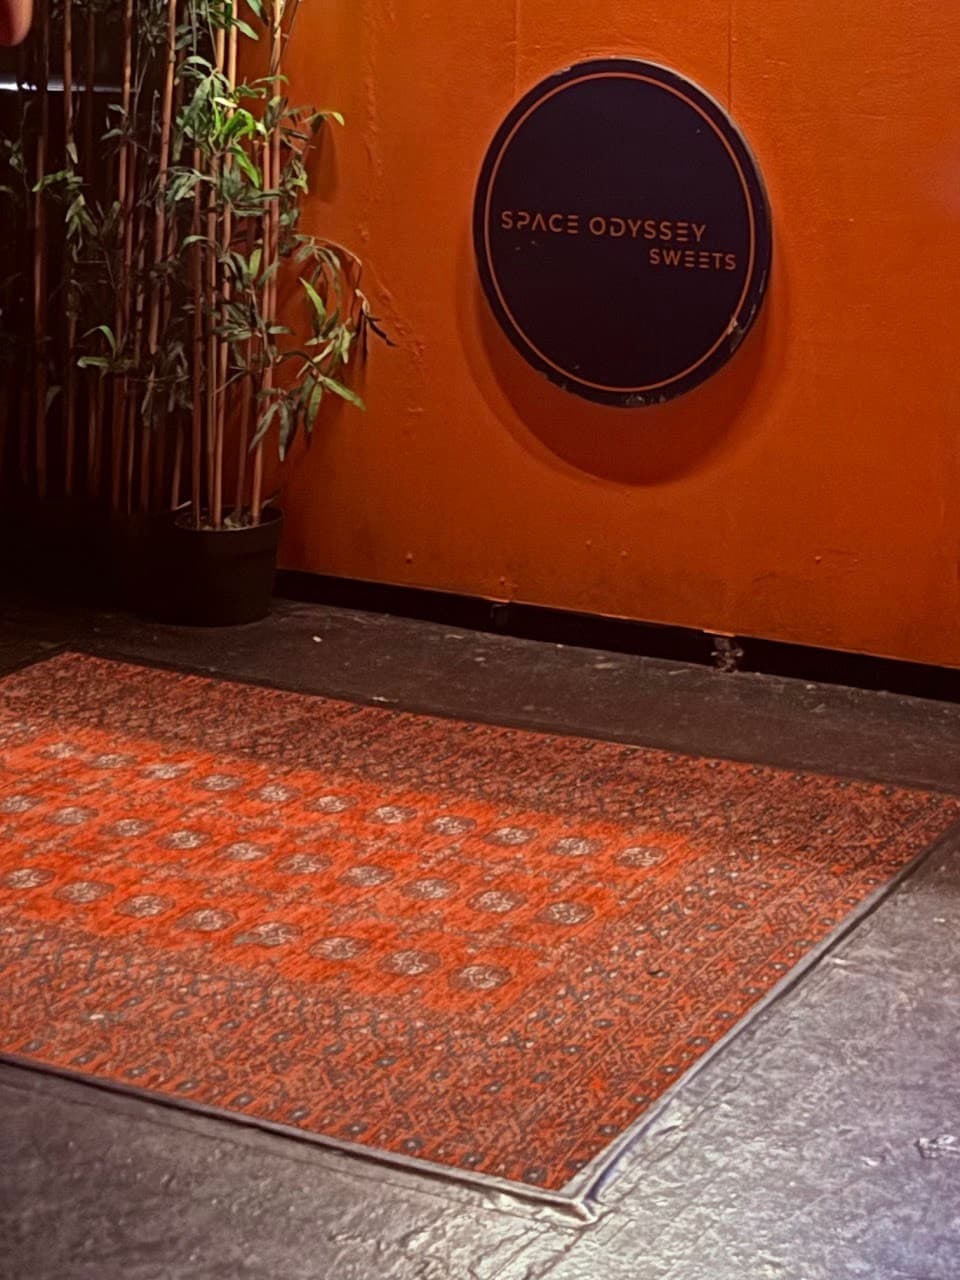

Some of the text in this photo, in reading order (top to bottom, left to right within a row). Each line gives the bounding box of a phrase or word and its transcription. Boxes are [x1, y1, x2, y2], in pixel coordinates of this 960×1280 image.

[501, 210, 706, 243] SPACE ODYSSEY
[649, 247, 737, 271] SWEETS
